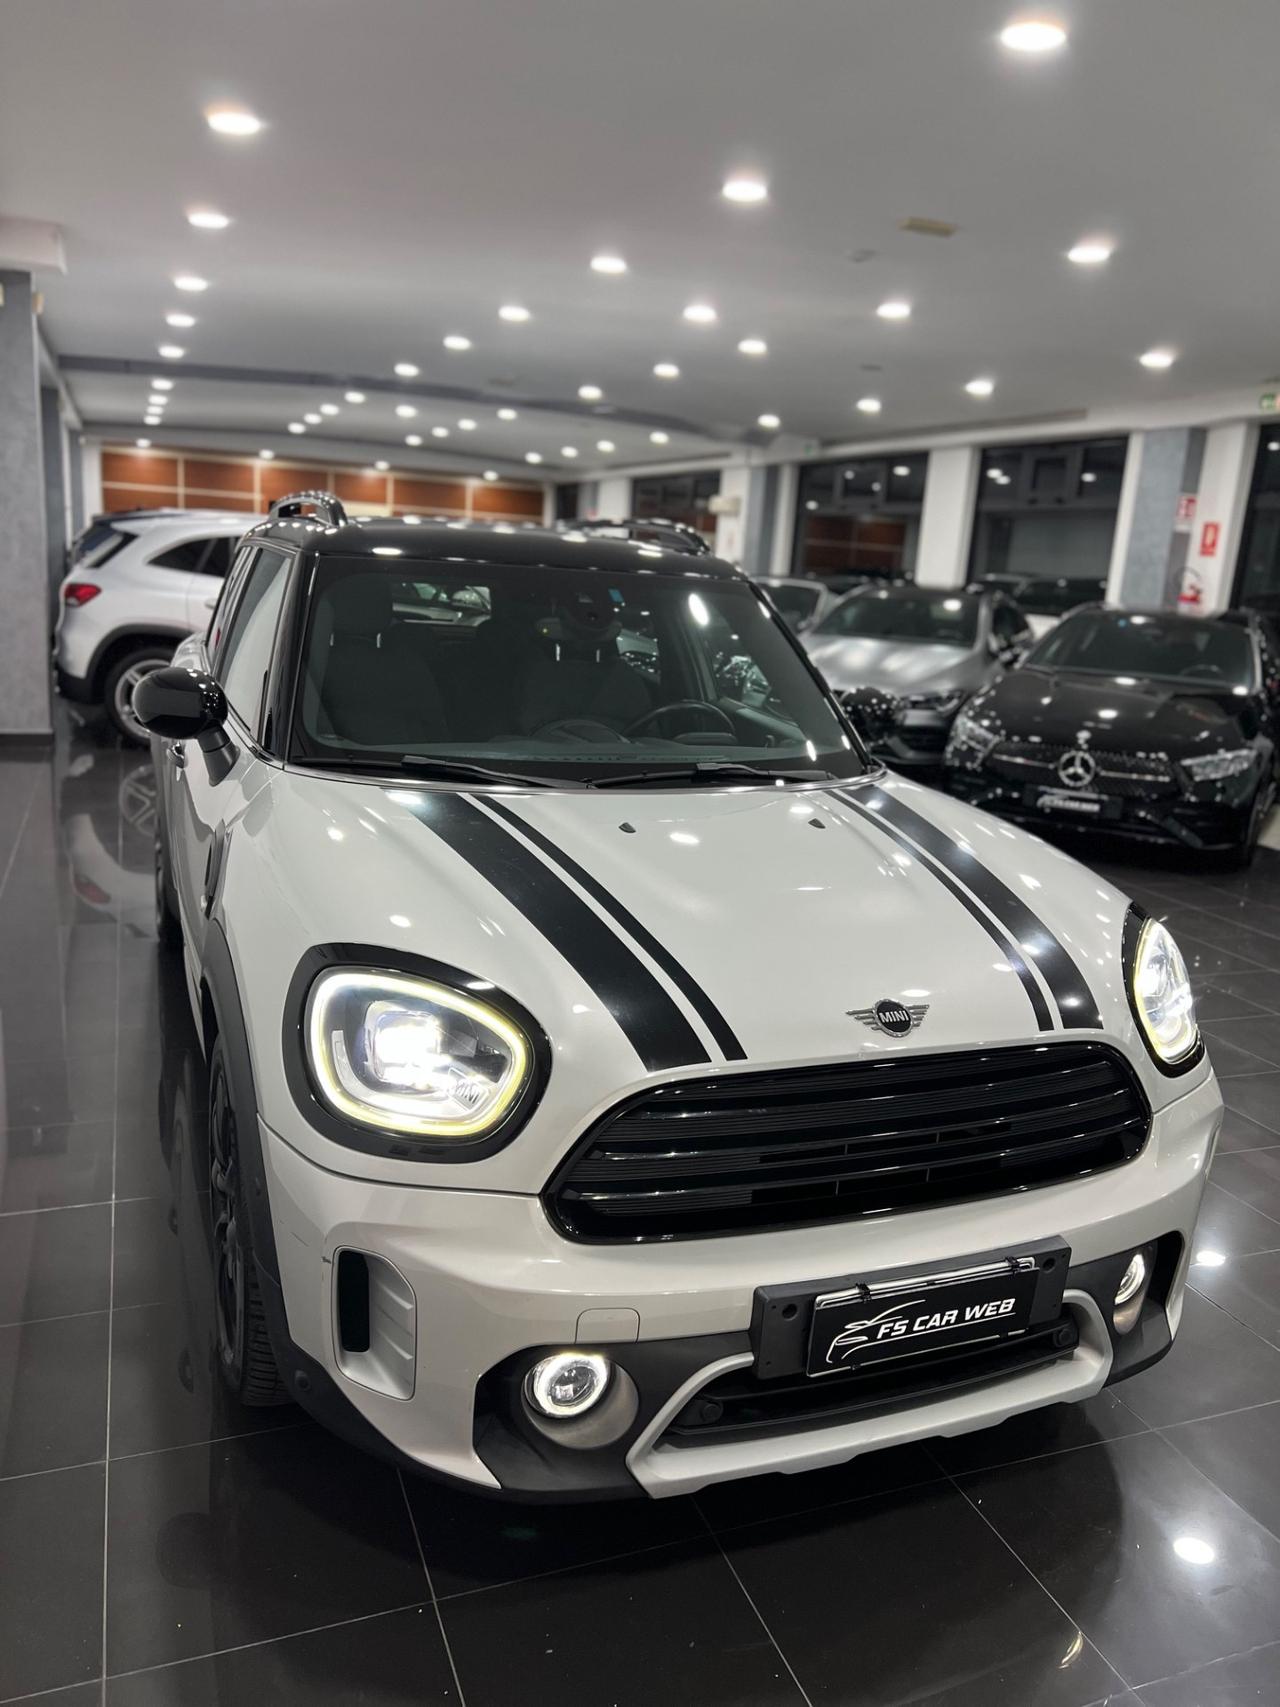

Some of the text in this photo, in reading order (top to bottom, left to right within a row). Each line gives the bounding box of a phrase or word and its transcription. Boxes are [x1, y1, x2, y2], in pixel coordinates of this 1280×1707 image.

[878, 1011, 909, 1023] MINI
[876, 1298, 1016, 1339] FS CAR WEB
